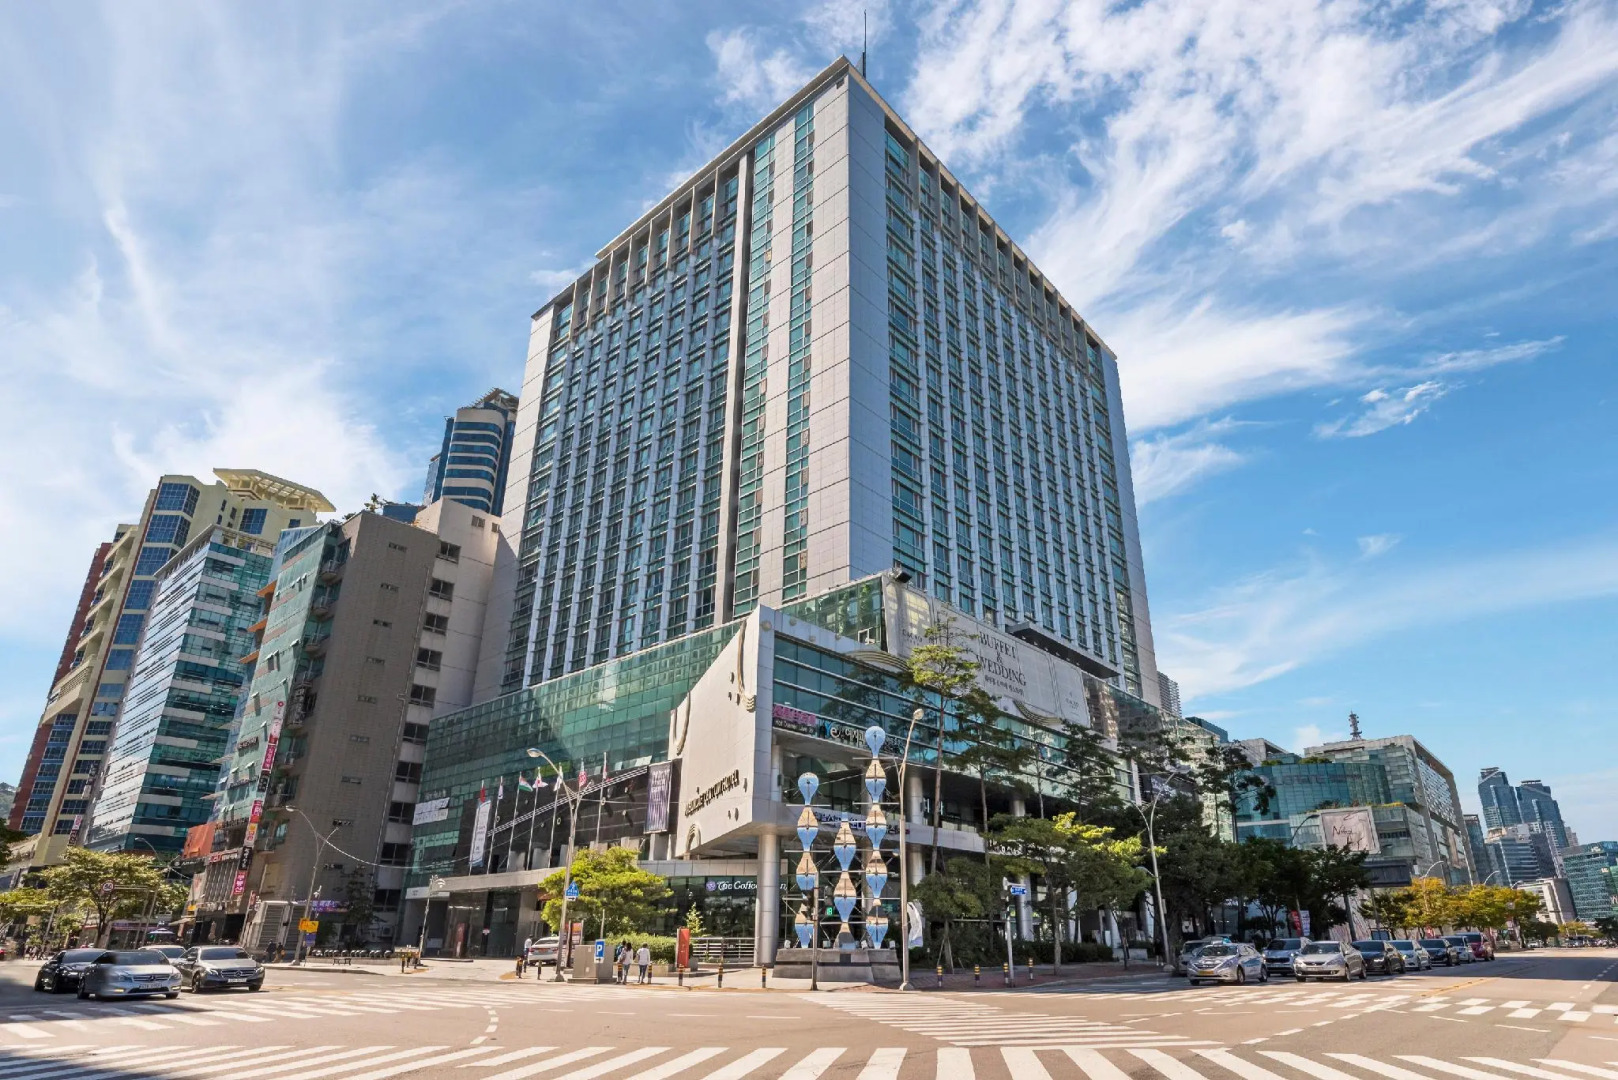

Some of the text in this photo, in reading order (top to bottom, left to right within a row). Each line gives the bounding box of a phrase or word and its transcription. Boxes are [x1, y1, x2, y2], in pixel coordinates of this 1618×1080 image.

[979, 631, 1017, 659] BUFFET
[976, 654, 1027, 686] WEDDING
[597, 944, 603, 956] P
